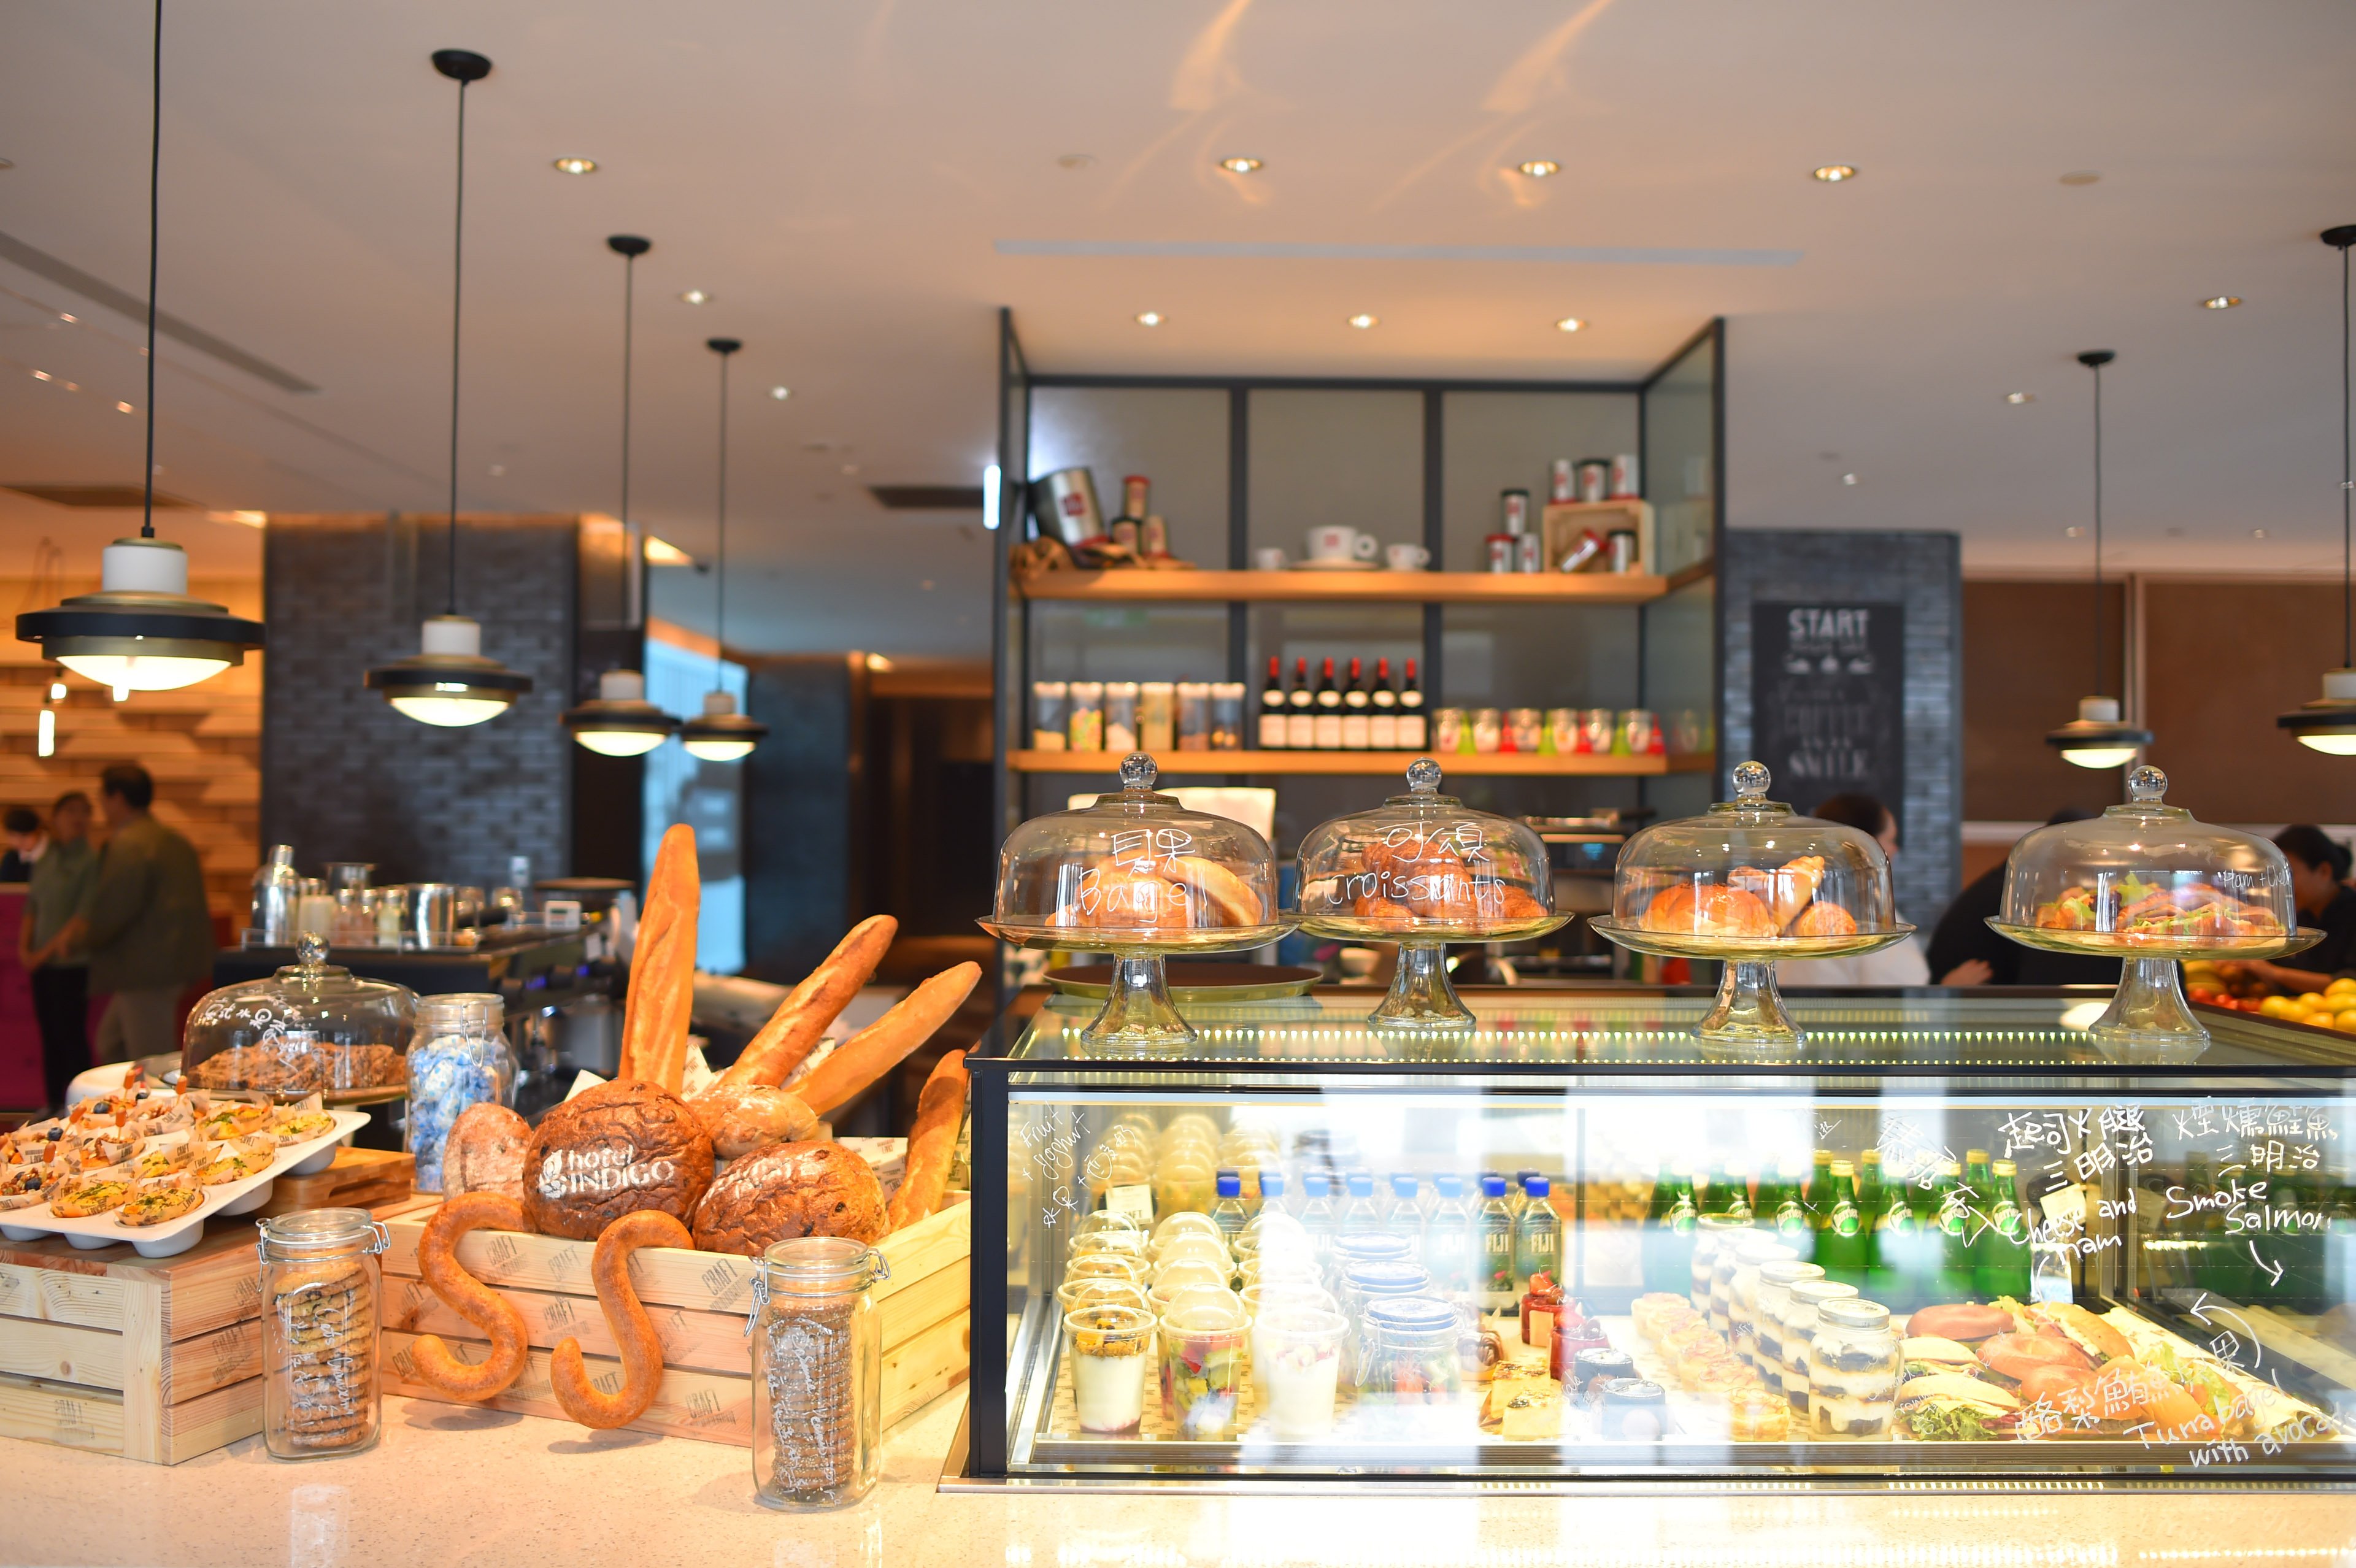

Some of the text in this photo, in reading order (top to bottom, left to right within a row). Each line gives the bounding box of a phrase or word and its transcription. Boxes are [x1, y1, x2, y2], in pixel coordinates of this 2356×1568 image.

[1788, 608, 1869, 640] START
[1111, 828, 1196, 878] 貝果
[1374, 821, 1490, 863] 可頌
[2223, 869, 2255, 888] Ham
[1079, 867, 1207, 923] Bagel
[1020, 1100, 1063, 1148] Fruit
[177, 1143, 190, 1156] CRAFT
[568, 1143, 634, 1170] hotel
[2043, 1132, 2153, 1191] 三明治
[2216, 1140, 2320, 1177] 三明治
[571, 1161, 674, 1193] INDIGO
[2096, 1188, 2136, 1219] and
[2166, 1178, 2267, 1218] Smoke
[2225, 1202, 2331, 1234] Salmon
[487, 1235, 517, 1265] CRAFT
[1485, 1234, 1509, 1253] FIJI
[1531, 1233, 1554, 1253] FIJI
[701, 1258, 738, 1296] CRAFT
[685, 1388, 721, 1420] CRAFT
[2123, 1368, 2286, 1450] Tuna bagel
[2190, 1438, 2249, 1468] with
